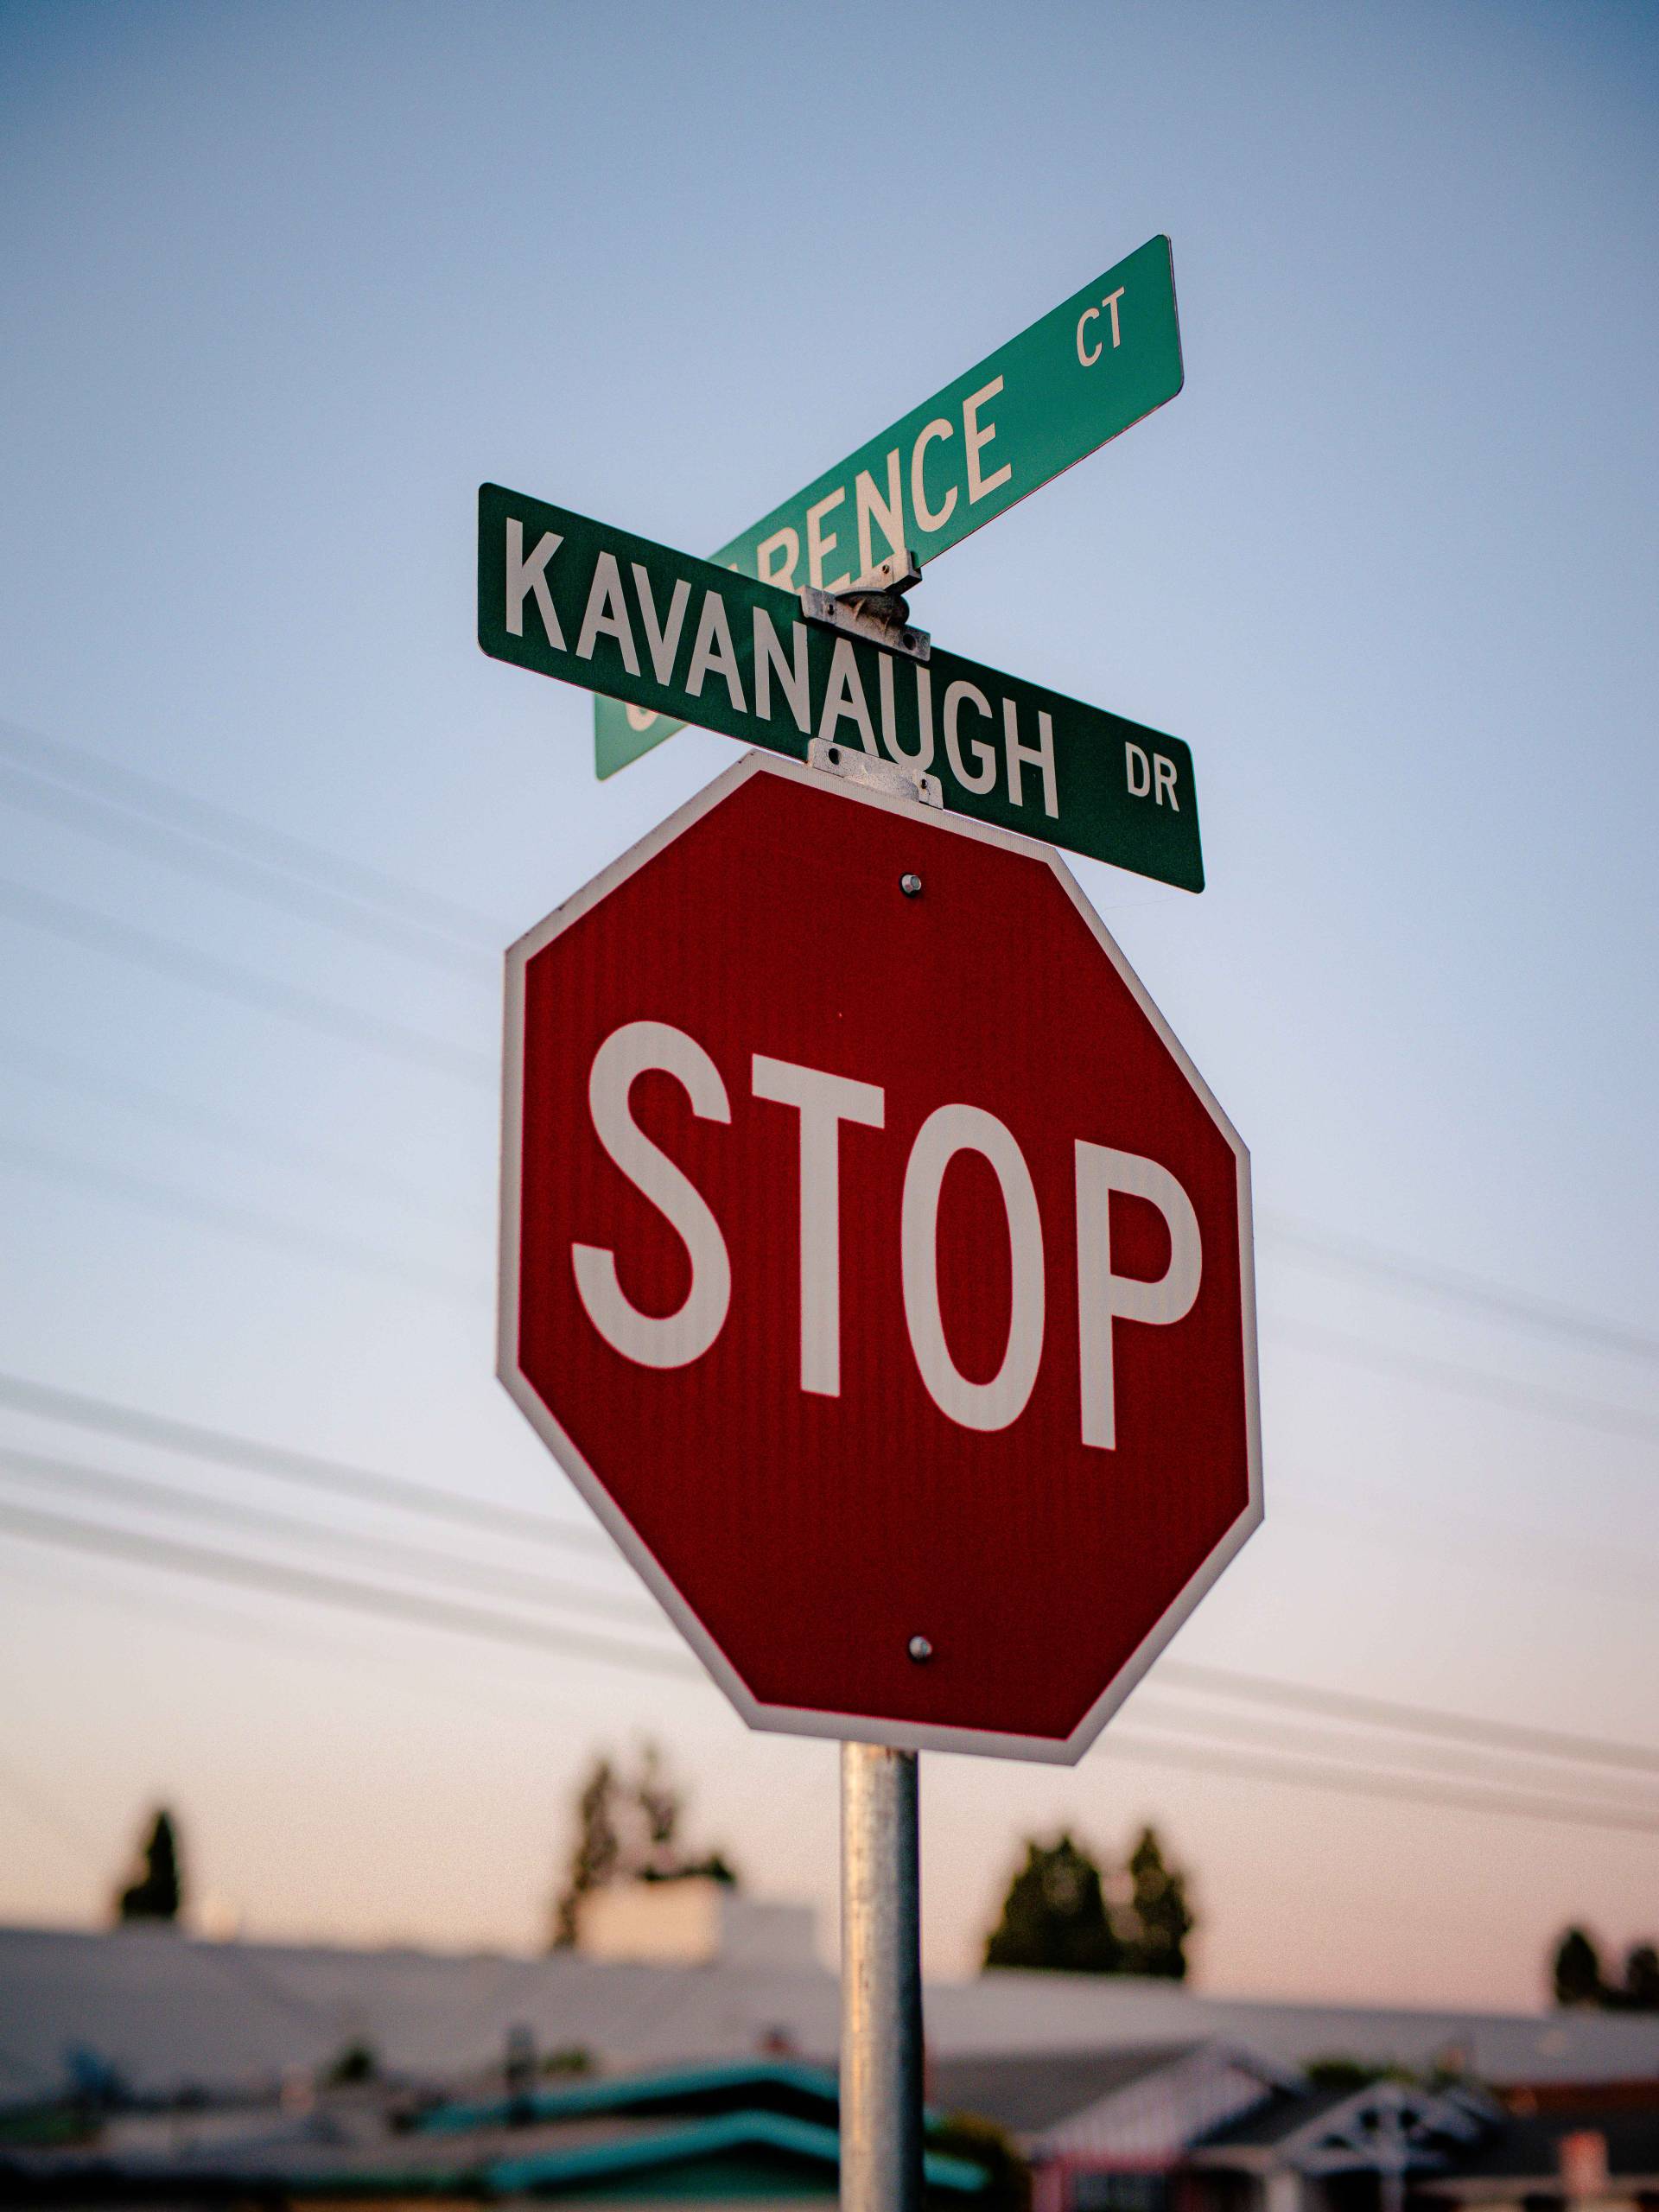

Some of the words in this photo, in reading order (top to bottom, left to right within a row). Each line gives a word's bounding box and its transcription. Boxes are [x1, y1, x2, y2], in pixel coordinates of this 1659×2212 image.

[1075, 286, 1125, 368] CT
[505, 517, 1059, 819] KAVANAUGH
[1125, 741, 1180, 812] DR
[571, 1020, 1203, 1452] STOP
